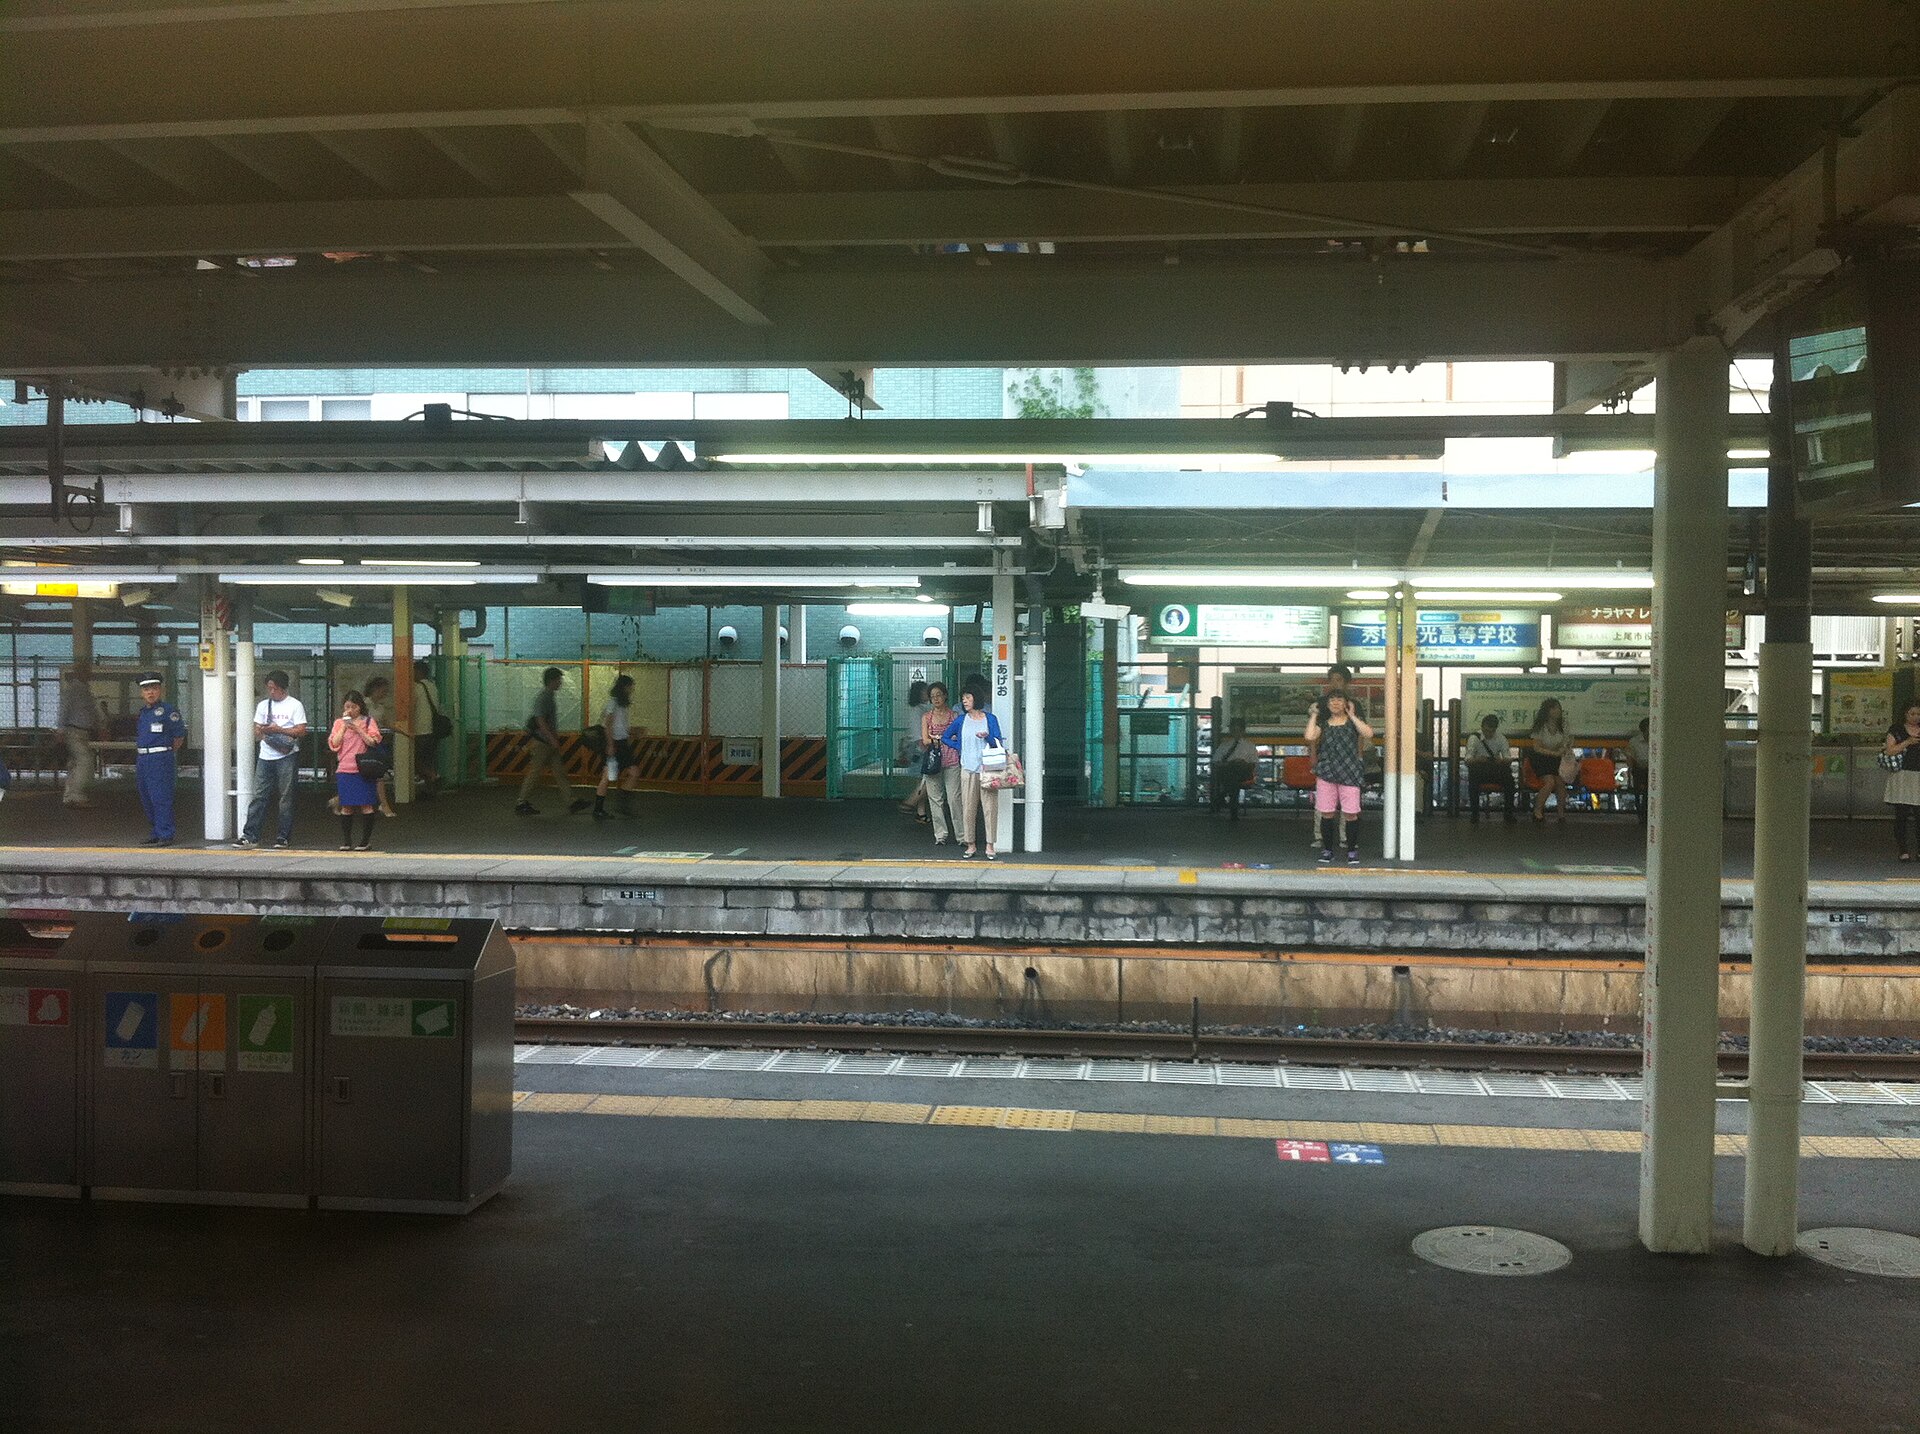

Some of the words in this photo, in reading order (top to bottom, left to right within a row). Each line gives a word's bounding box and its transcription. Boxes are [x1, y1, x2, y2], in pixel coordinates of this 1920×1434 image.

[1591, 607, 1636, 620] ナラヤマ
[1362, 625, 1517, 645] 秀光高等学校
[997, 664, 1008, 697] あげお
[1334, 1152, 1362, 1163] 4
